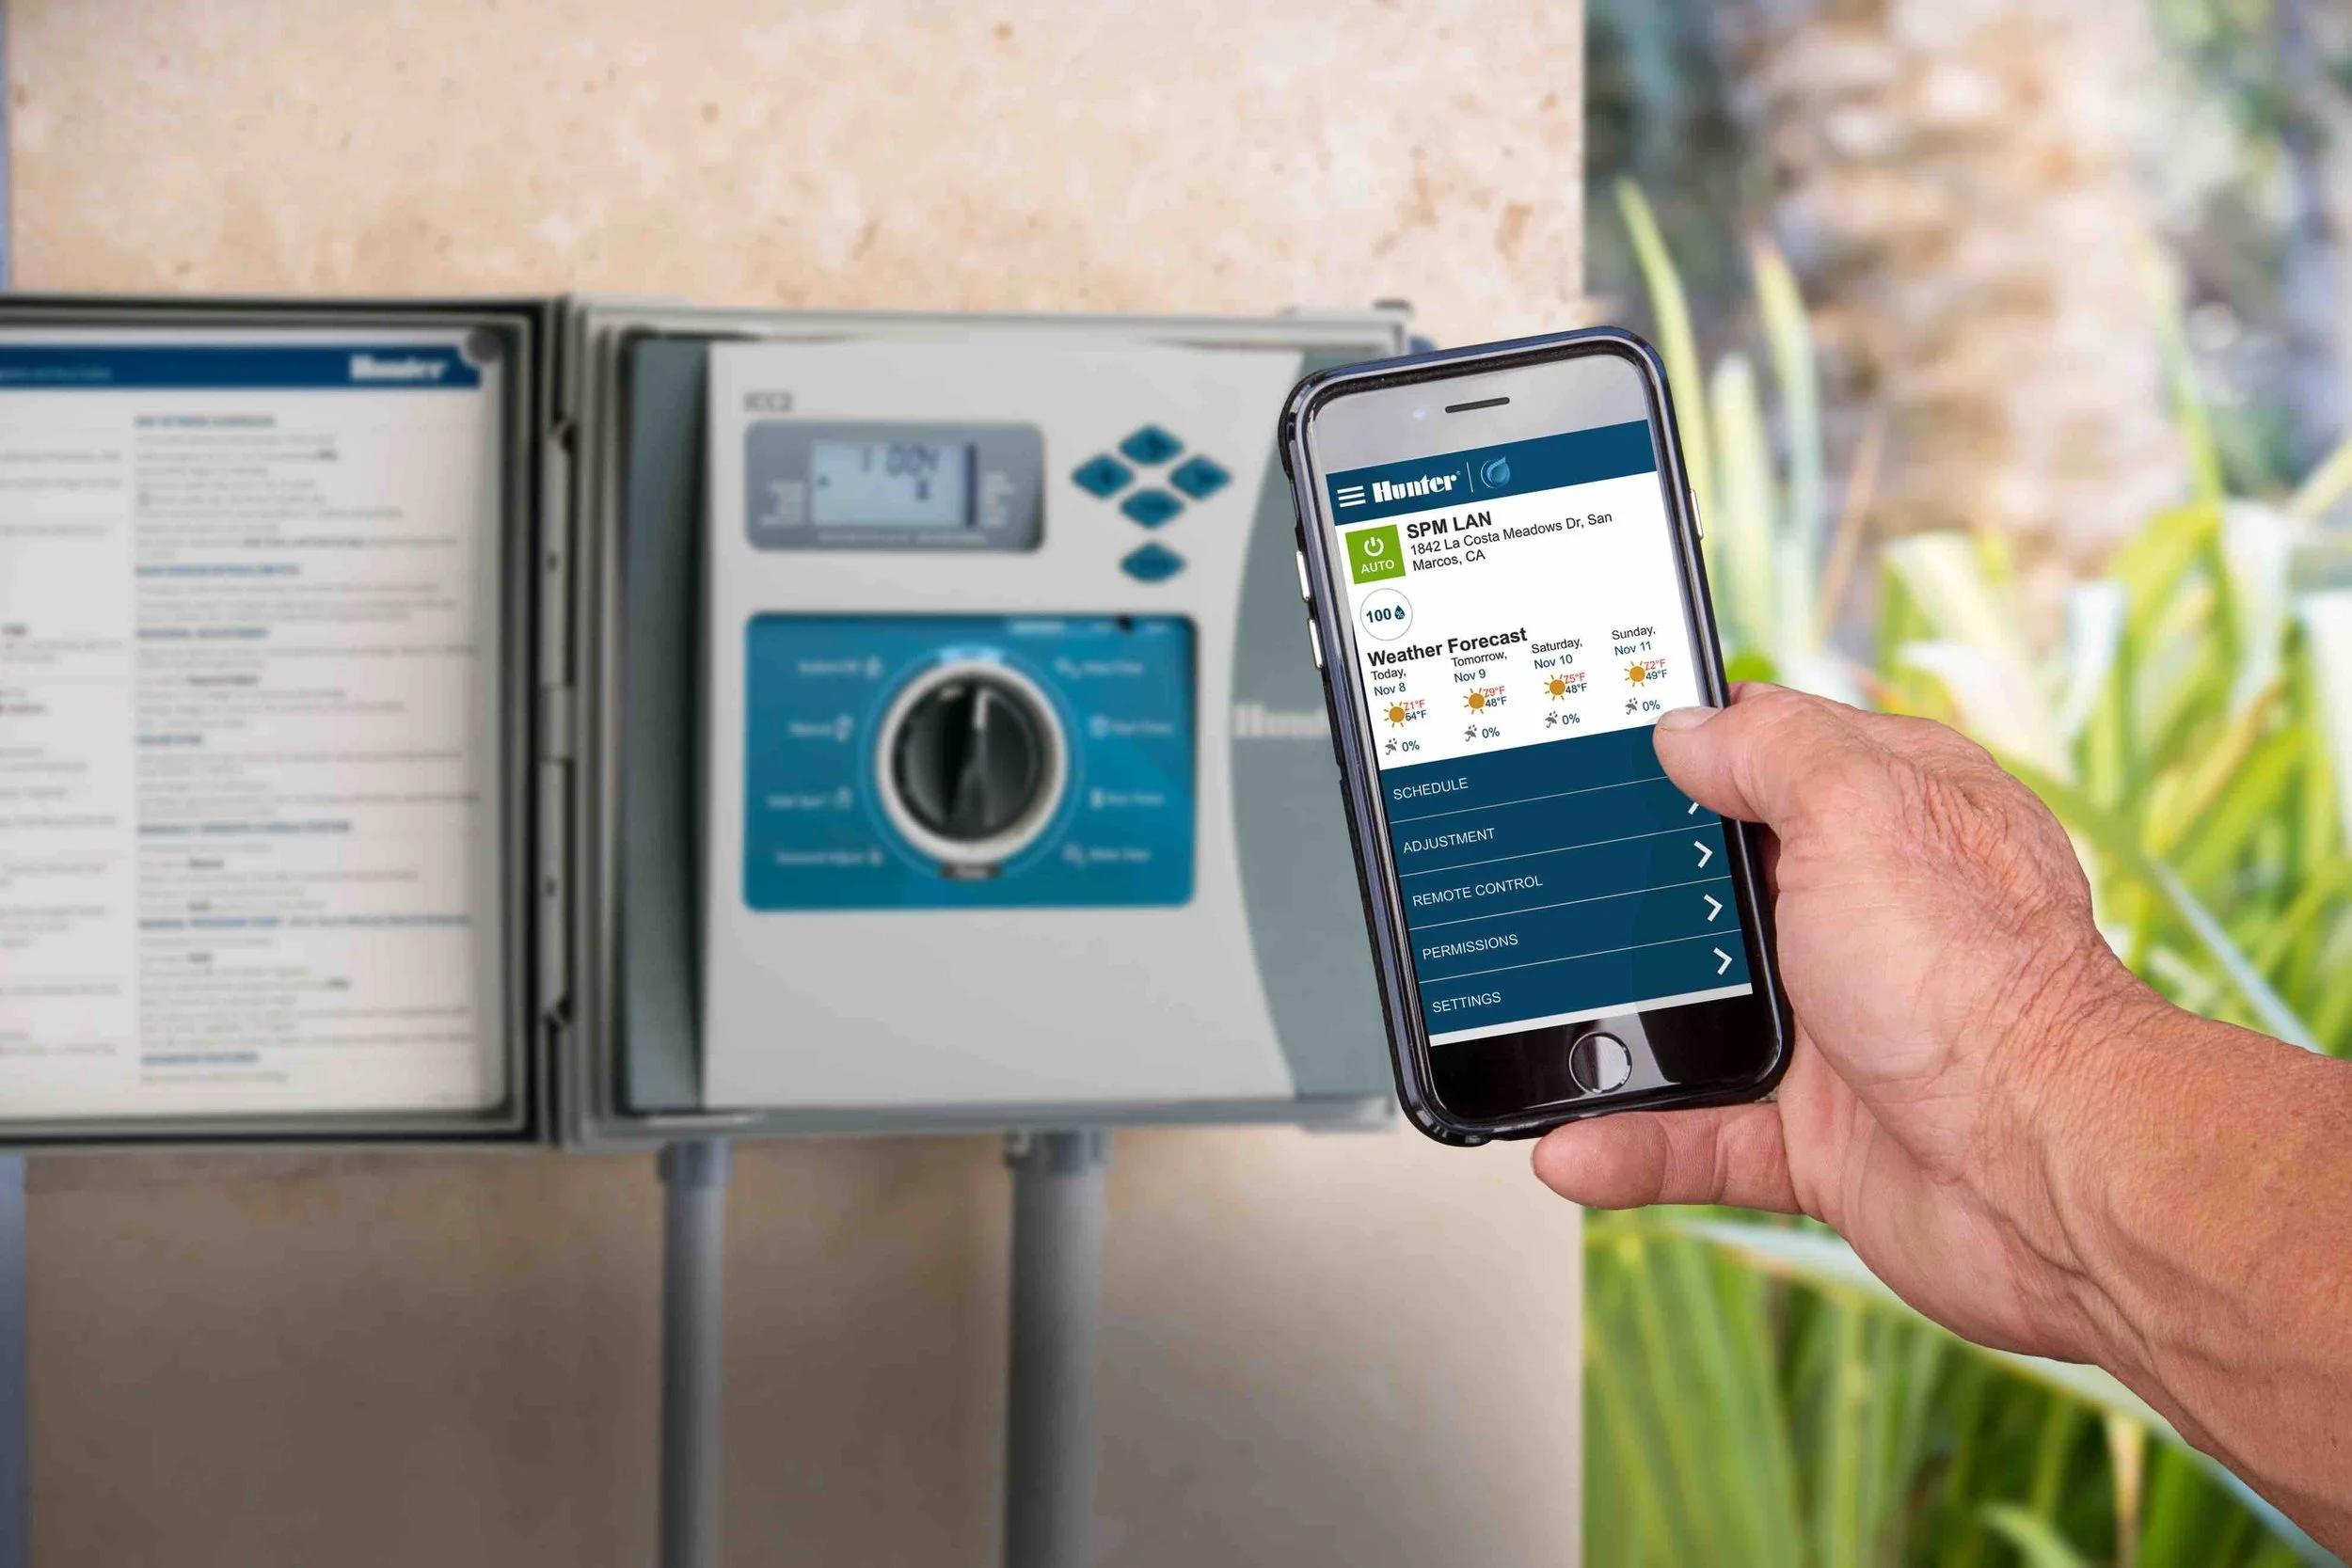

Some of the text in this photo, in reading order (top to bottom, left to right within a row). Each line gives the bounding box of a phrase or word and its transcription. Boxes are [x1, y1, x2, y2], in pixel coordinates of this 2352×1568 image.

[1406, 511, 1492, 539] SPM LAN
[1410, 513, 1613, 555] 1842 La Costa Meadows Dr, San
[1361, 560, 1395, 574] AUTO
[1412, 549, 1486, 572] Marcos, CA
[1612, 626, 1656, 641] Sunday,
[1367, 627, 1528, 667] Weather Forecast
[1532, 639, 1582, 654] Saturday,
[1613, 641, 1652, 657] Nov 11
[1451, 651, 1508, 668] Tomorrow,
[1534, 654, 1574, 670] Nov 10
[1371, 669, 1406, 681] Today,
[1454, 669, 1486, 684] Nov 9
[1374, 682, 1406, 697] Nov 8
[1642, 700, 1661, 712] 0%
[1561, 713, 1581, 725] 0%
[1481, 726, 1501, 739] 0%
[1402, 740, 1421, 752] 0%
[1392, 777, 1469, 800] SCHEDULE
[1403, 827, 1496, 854] ADJUSTMENT
[1412, 875, 1544, 907] REMOTE CONTROL
[1422, 933, 1519, 960] PERMISSIONS
[1432, 990, 1502, 1014] SETTINGS
